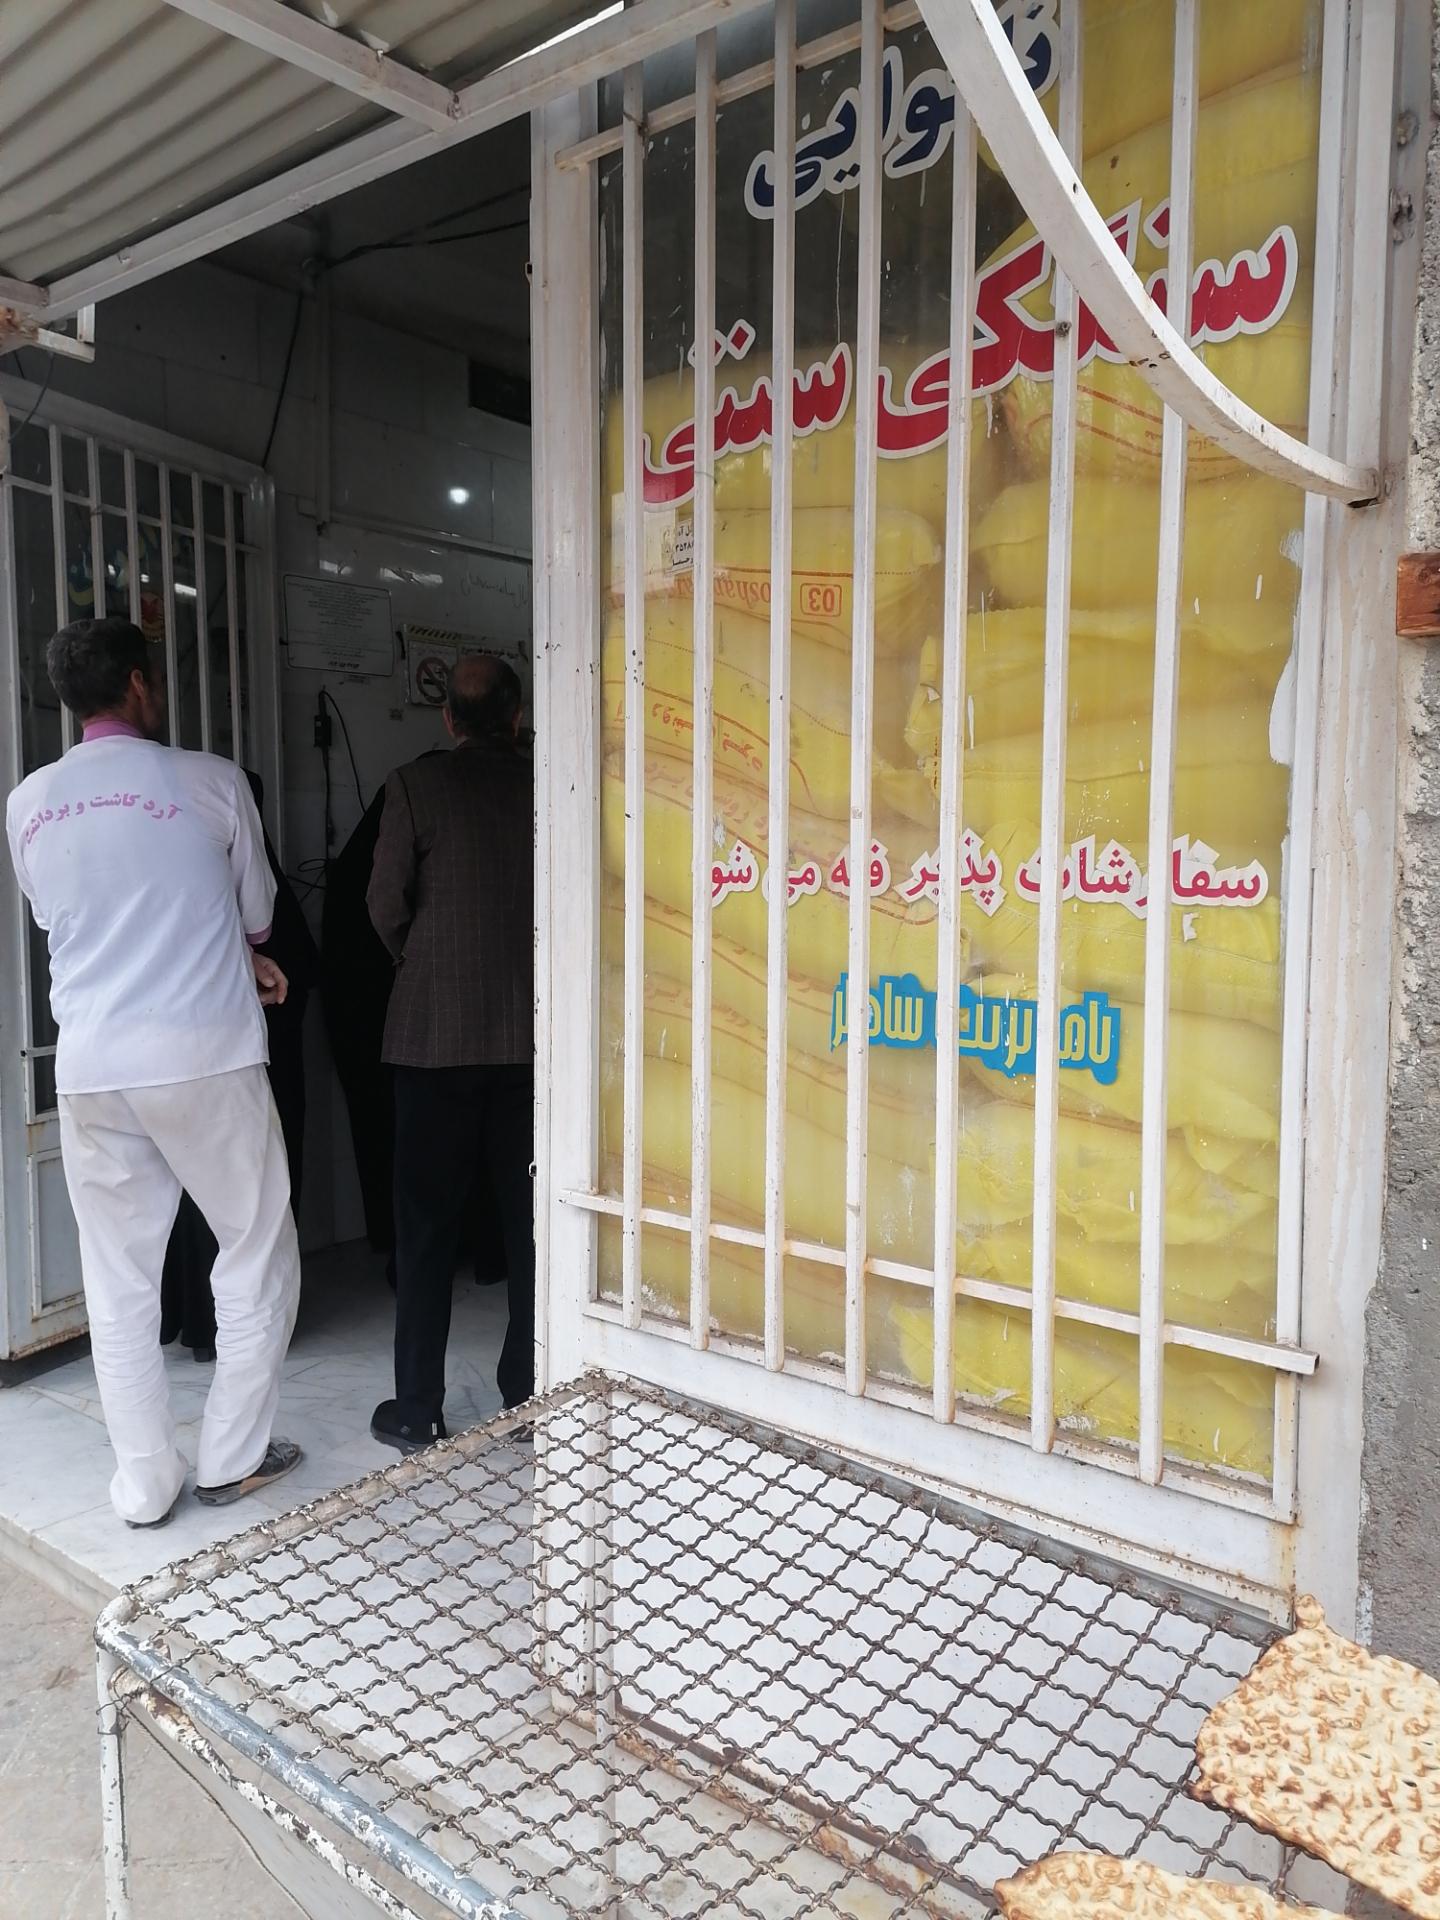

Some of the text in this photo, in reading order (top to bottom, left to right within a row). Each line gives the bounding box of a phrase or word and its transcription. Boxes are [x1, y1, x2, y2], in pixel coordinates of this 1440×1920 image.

[753, 3, 1052, 207] نوایی
[808, 587, 835, 613] 03
[76, 801, 85, 815] و
[90, 793, 141, 808] کاشت
[143, 800, 183, 819] آرد
[700, 846, 753, 898] شو
[831, 836, 996, 906] پذیرفه
